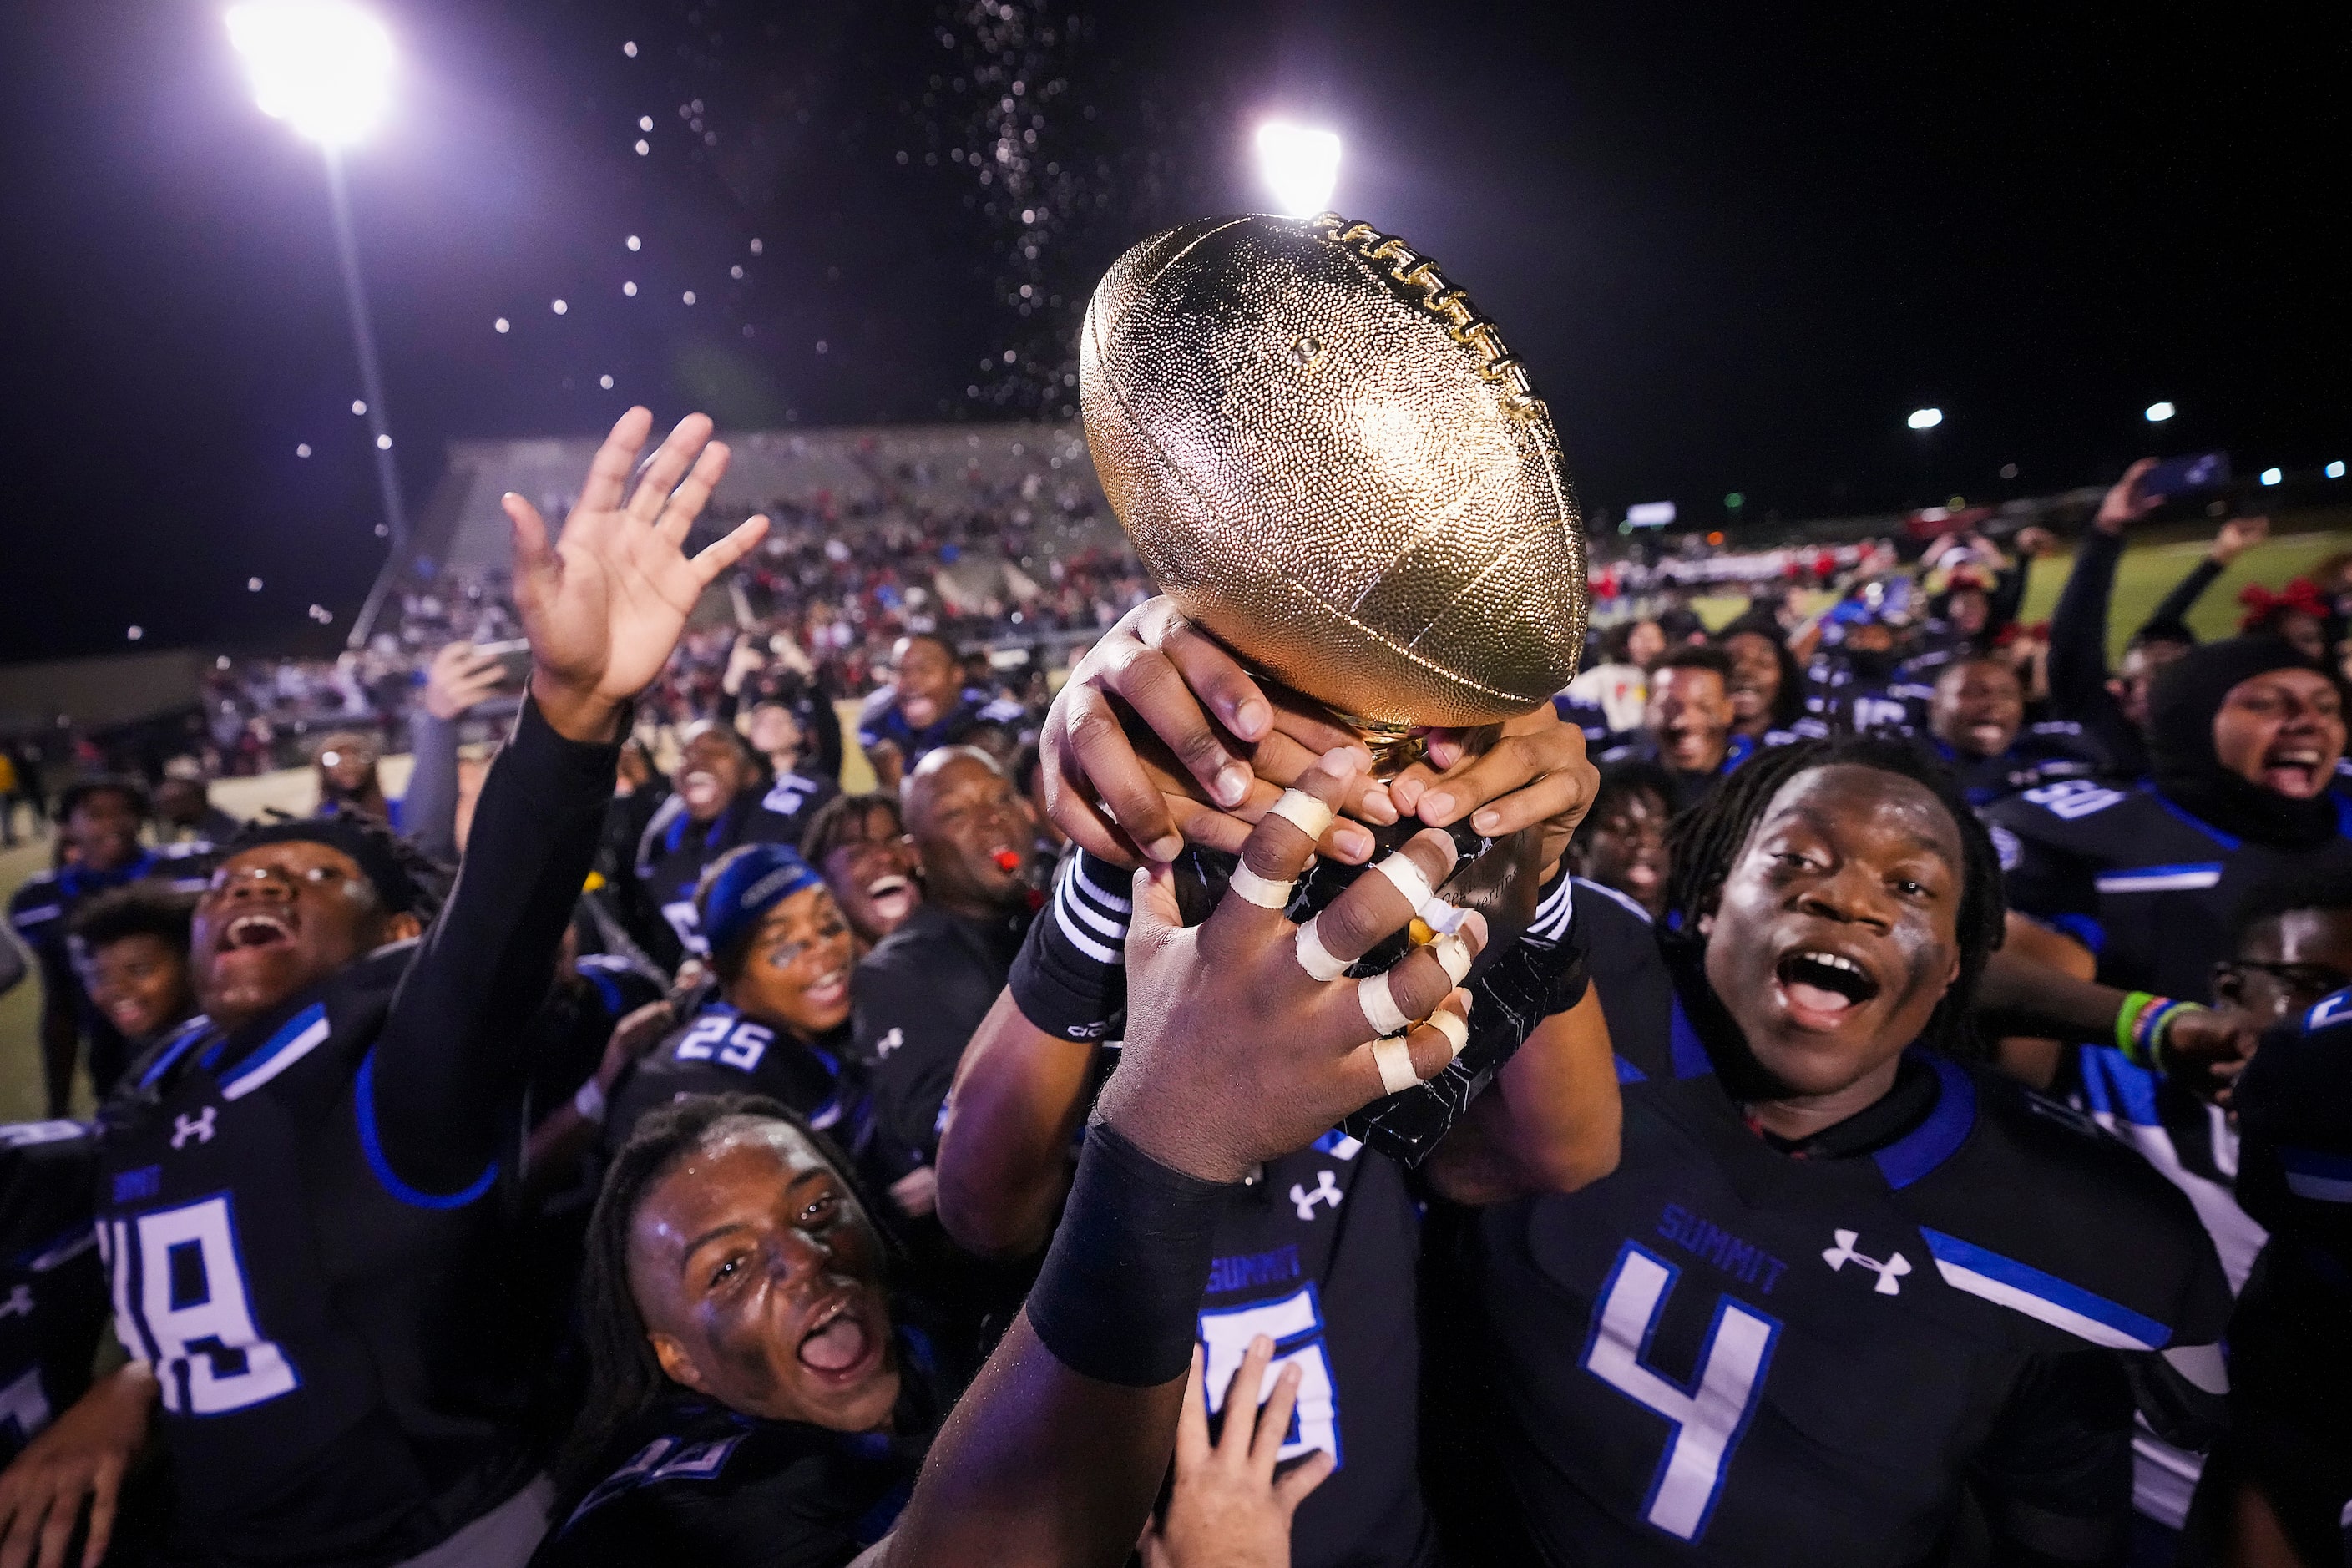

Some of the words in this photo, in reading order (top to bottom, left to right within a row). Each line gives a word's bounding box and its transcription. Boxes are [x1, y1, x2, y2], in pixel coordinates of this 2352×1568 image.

[673, 1014, 776, 1073] 25
[1656, 1202, 1788, 1296] SUMMIT
[1577, 1238, 1784, 1545] 4
